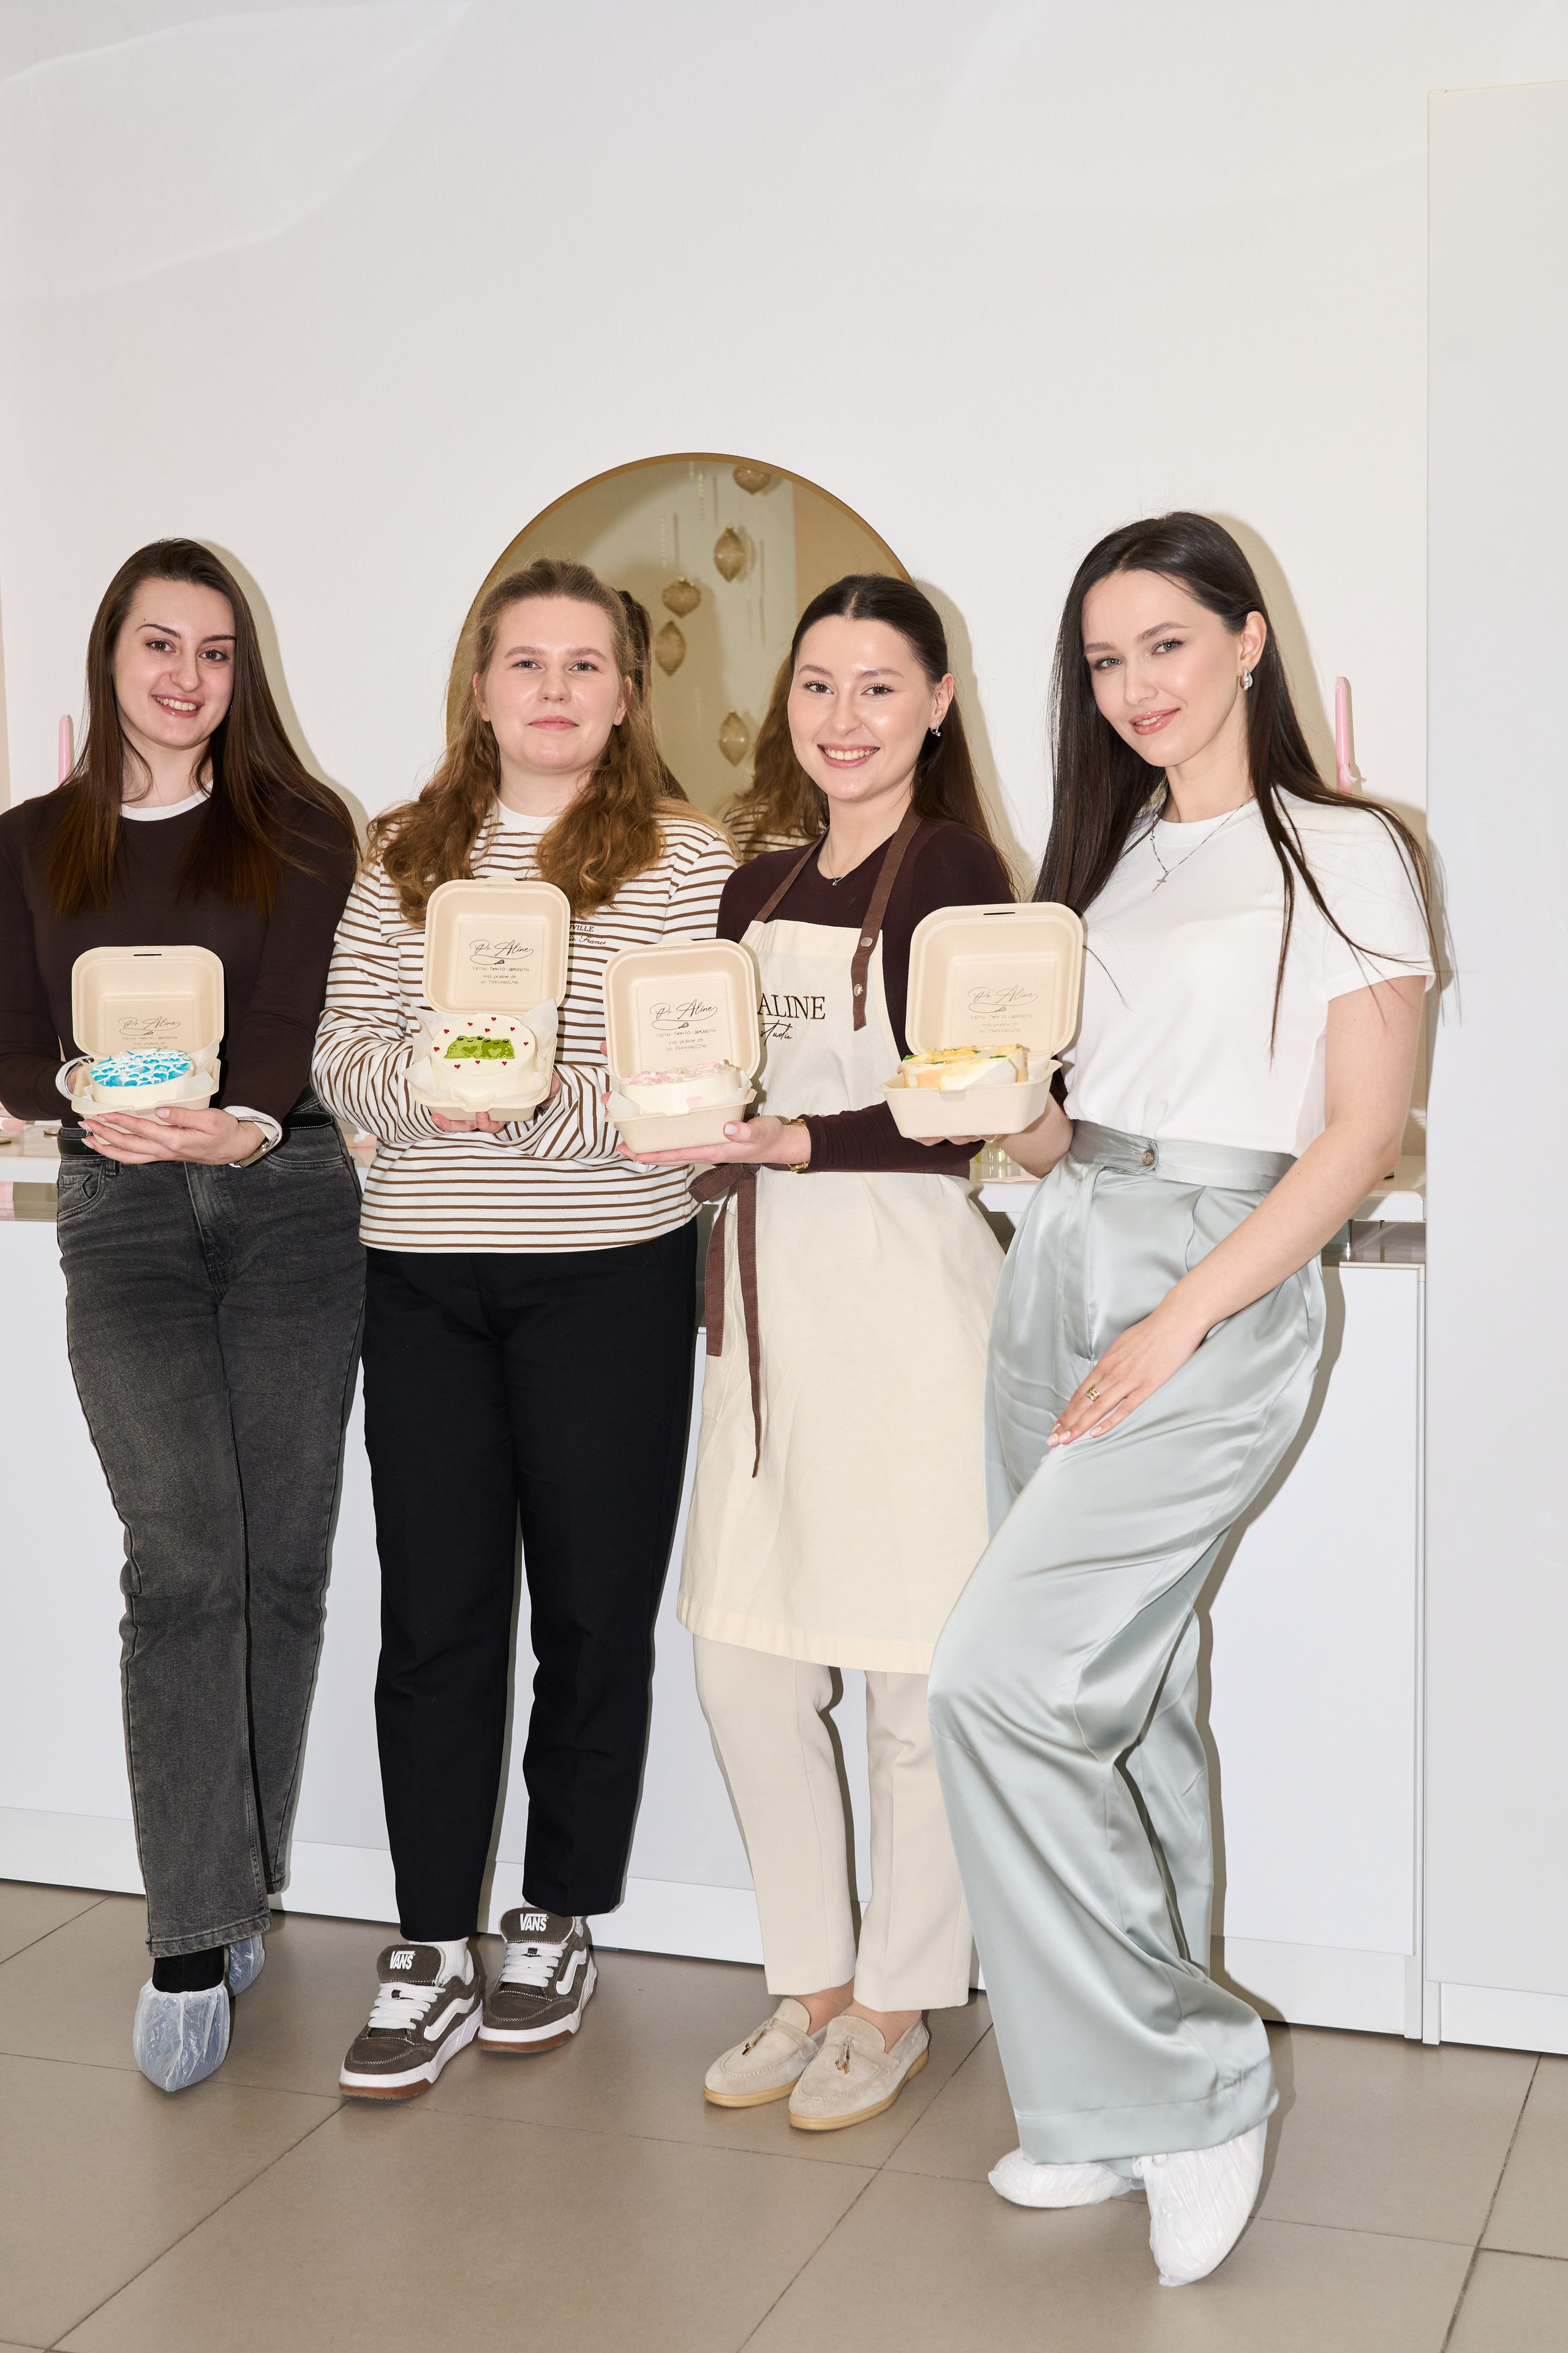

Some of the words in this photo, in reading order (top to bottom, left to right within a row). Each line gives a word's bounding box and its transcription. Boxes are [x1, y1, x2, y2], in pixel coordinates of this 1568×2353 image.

[494, 939, 533, 956] Aline
[579, 934, 606, 945] France
[995, 984, 1038, 1003] Aline
[676, 999, 718, 1019] Aline
[757, 992, 826, 1020] ALINE
[142, 1016, 181, 1029] Aline
[520, 1913, 548, 1932] VANS
[390, 1951, 415, 1970] VANS
